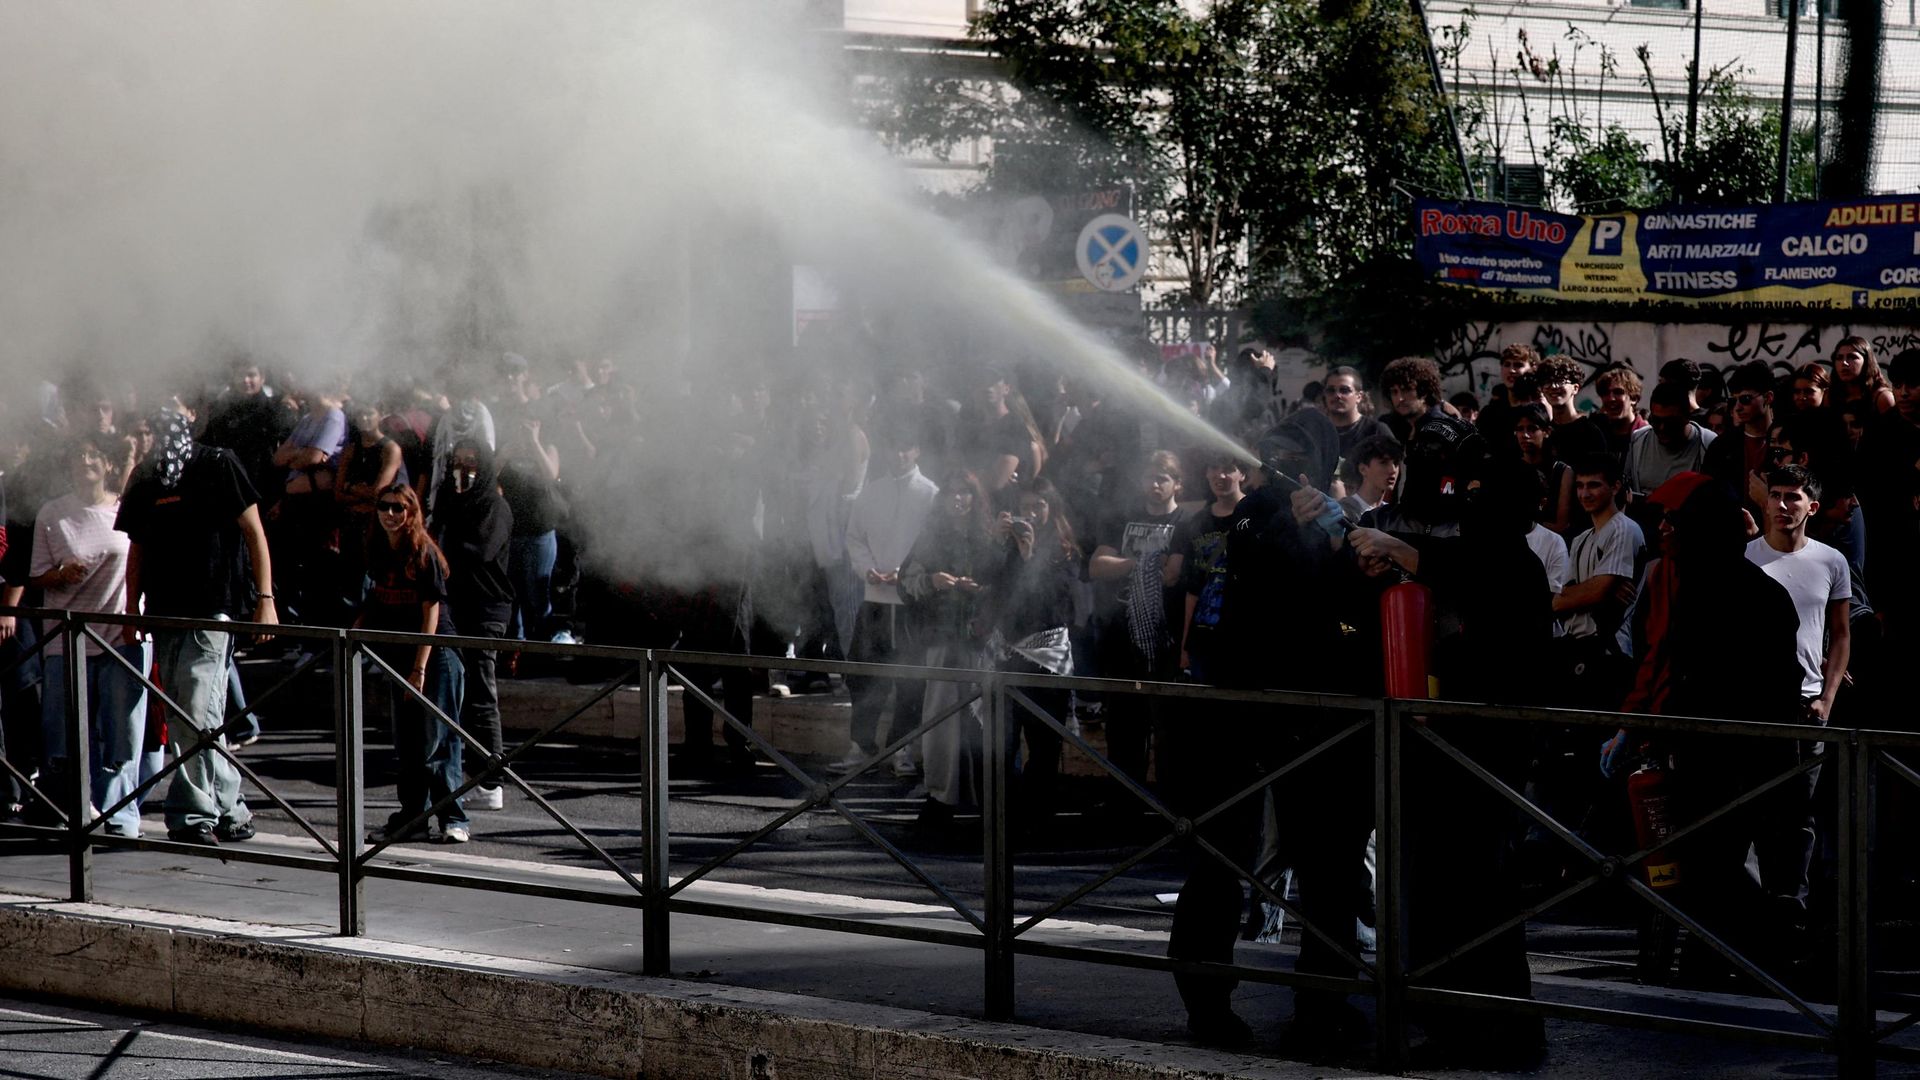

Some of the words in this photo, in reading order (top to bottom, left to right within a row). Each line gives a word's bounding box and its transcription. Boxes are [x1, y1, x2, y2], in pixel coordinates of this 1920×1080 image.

[1643, 213, 1758, 231] GINNASTICHE
[1824, 203, 1897, 227] ADULTI
[1900, 202, 1916, 223] E
[1420, 208, 1502, 238] Roma
[1506, 209, 1567, 244] Uno
[1594, 219, 1622, 250] P
[1646, 243, 1683, 260] ARTI
[1684, 241, 1762, 260] MARZIALI
[1780, 232, 1869, 257] CALCIO
[1498, 257, 1544, 270] sportivo
[1574, 262, 1624, 271] PARCHEGGIO
[1496, 270, 1552, 285] Trastevere
[1653, 269, 1738, 290] FITNESS
[1764, 265, 1837, 281] FLAMENCO
[1562, 285, 1589, 293] LARGO
